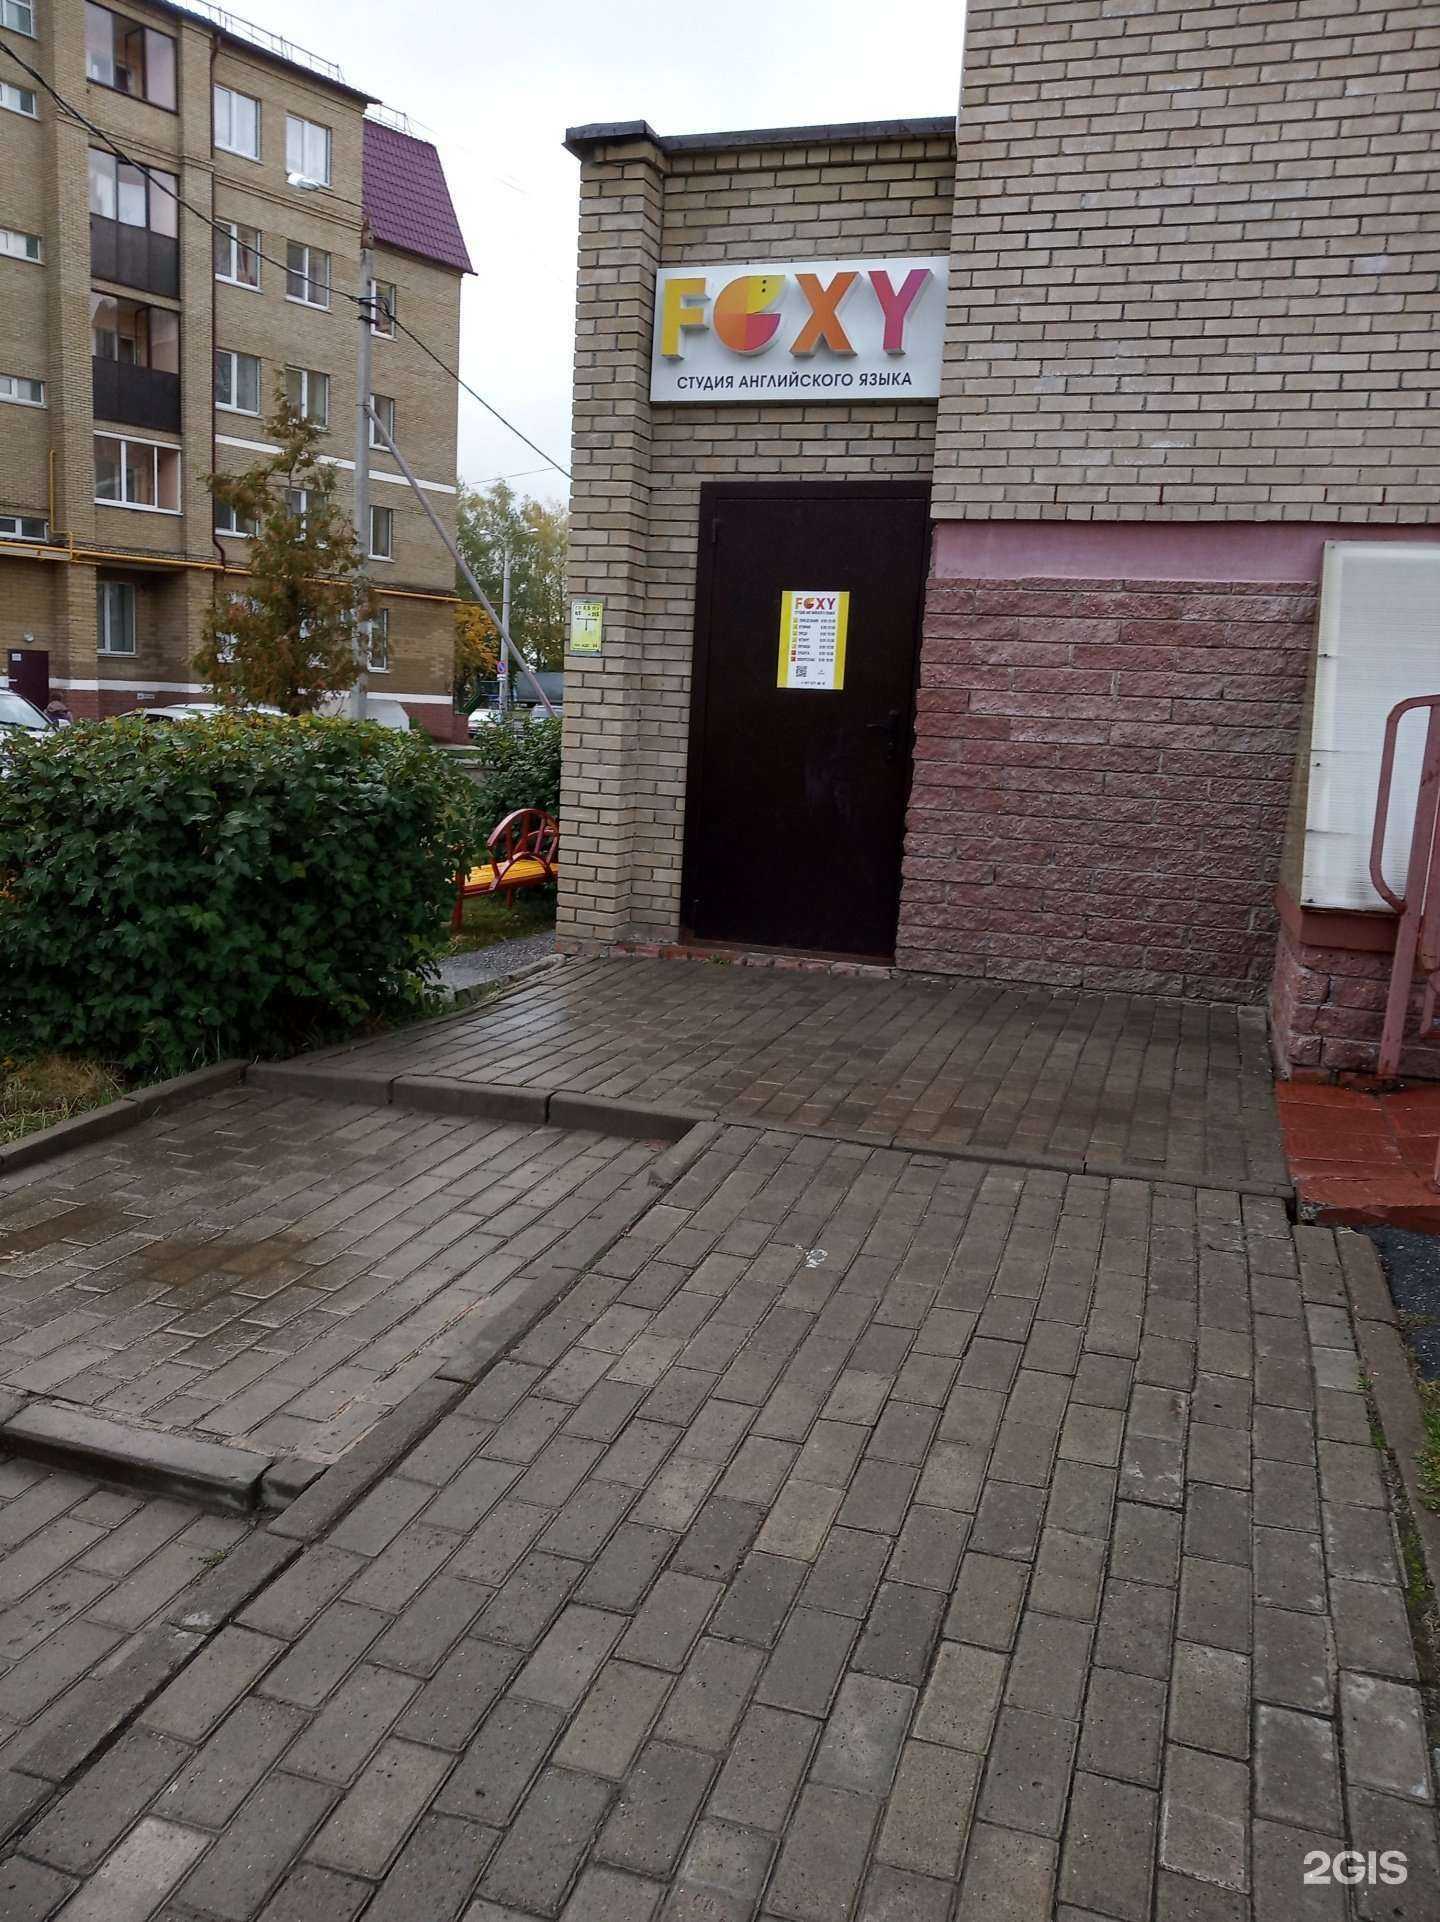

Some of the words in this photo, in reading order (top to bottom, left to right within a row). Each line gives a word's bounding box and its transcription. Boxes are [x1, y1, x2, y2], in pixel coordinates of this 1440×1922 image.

[661, 268, 932, 360] FOXY
[676, 375, 734, 391] СТУДИЯ
[738, 371, 853, 389] АНГЛИЙСКОГО
[858, 372, 912, 387] ЯЗЫКА
[795, 597, 836, 610] FOXY
